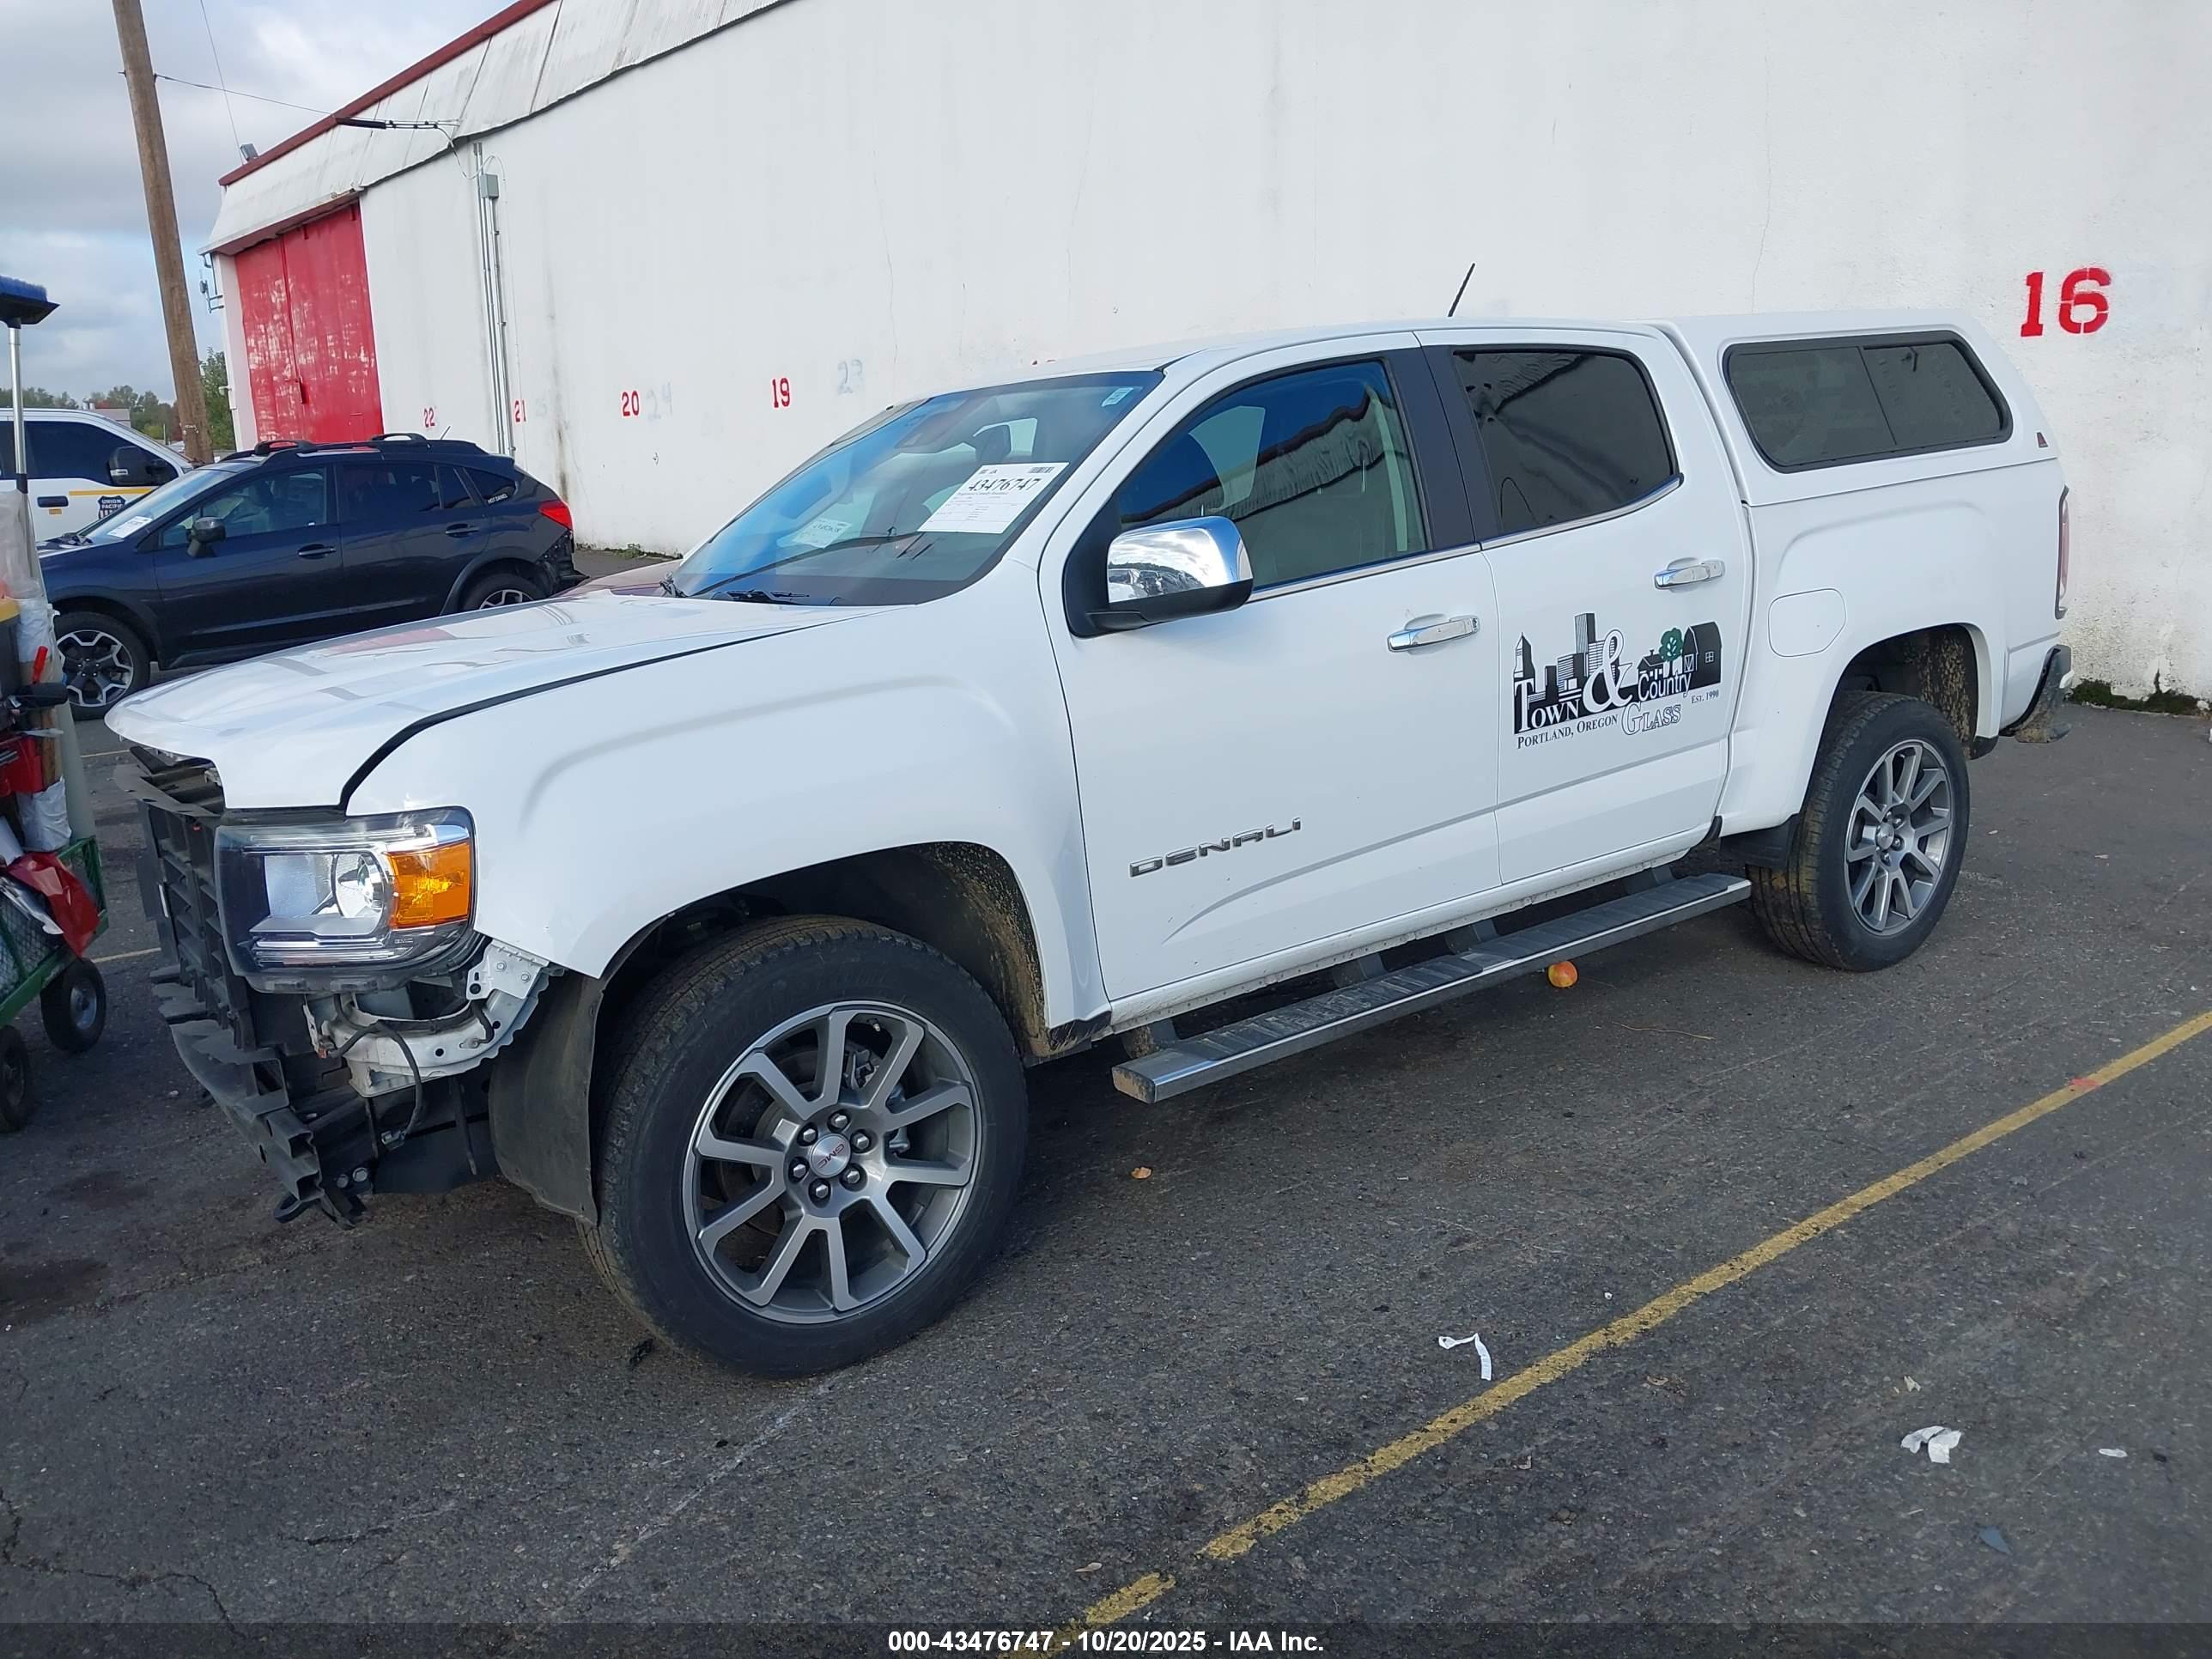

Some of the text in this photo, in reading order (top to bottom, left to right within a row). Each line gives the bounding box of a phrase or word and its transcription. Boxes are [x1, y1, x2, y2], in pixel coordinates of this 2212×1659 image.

[2020, 267, 2112, 337] 16
[622, 391, 640, 416] 20
[772, 378, 790, 408] 19
[424, 407, 435, 428] 22
[515, 400, 526, 422] 21
[969, 477, 1042, 491] 43476747
[1583, 629, 1633, 713] &
[1638, 672, 1692, 702] Country
[1705, 690, 1719, 701] 1990
[1577, 714, 1619, 733] OREGON
[1129, 817, 1301, 878] DENALI
[817, 1143, 844, 1168] GMC
